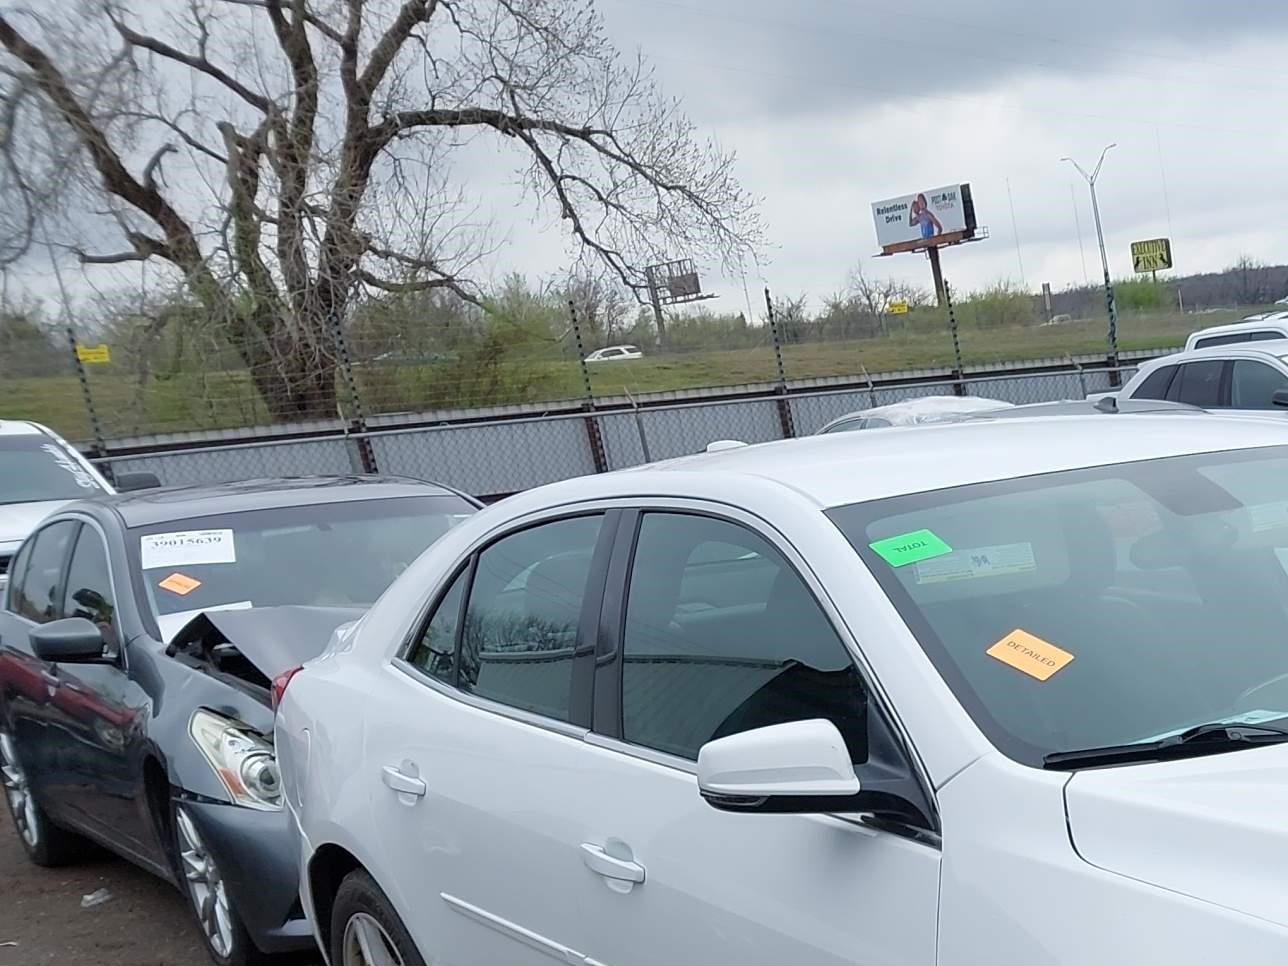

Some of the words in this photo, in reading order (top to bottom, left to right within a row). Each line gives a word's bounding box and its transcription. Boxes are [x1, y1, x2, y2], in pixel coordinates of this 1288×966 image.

[876, 202, 908, 216] Relentless
[885, 214, 902, 224] Drive
[1143, 254, 1159, 270] INN
[893, 540, 929, 553] TOTAL
[1007, 640, 1056, 667] DETAILED
